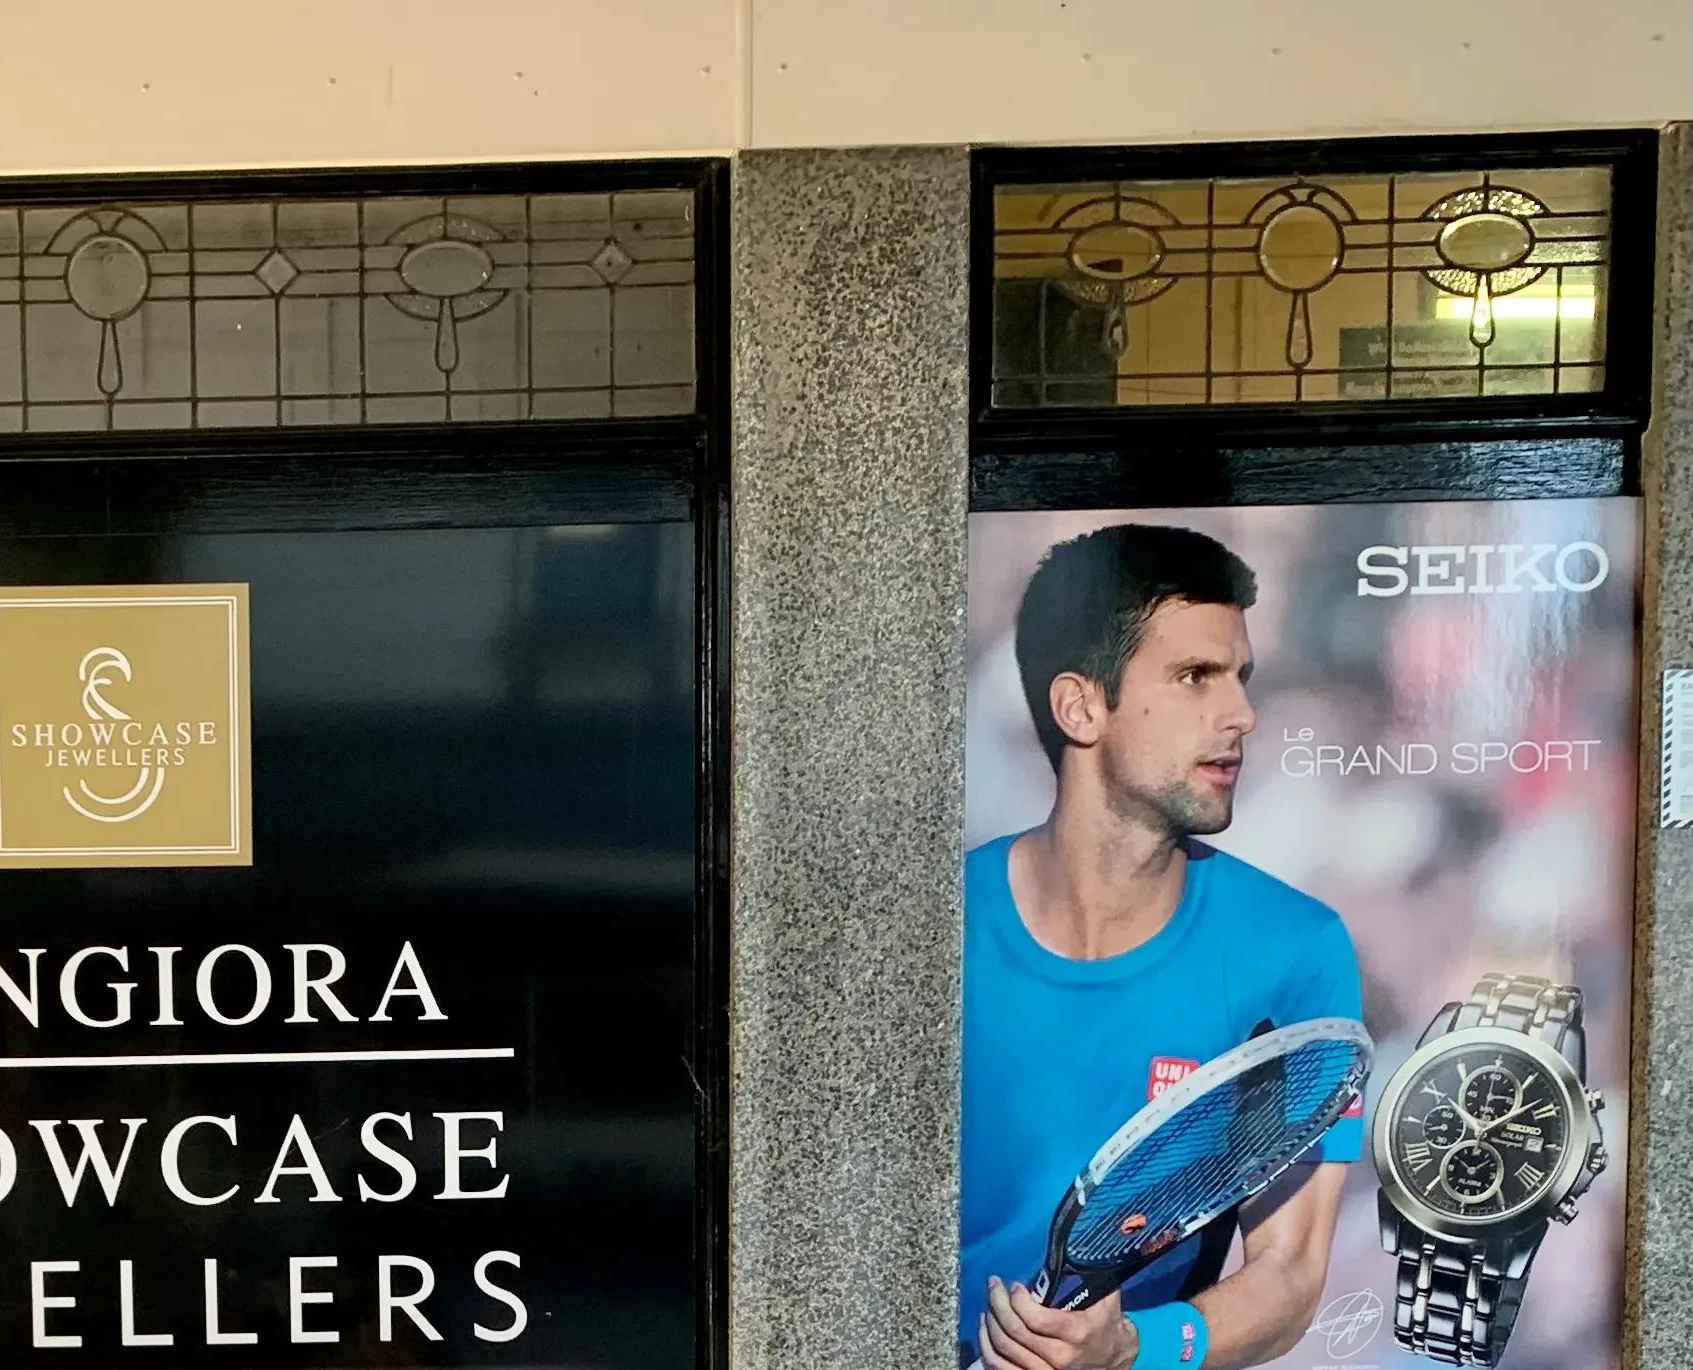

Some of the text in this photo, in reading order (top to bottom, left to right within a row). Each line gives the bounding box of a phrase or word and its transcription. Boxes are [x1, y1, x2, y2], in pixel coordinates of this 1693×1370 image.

[1356, 540, 1610, 597] SEIKO
[11, 721, 218, 748] SHOWCASE
[1283, 726, 1315, 742] Le
[45, 747, 186, 768] JEWELLERS
[1280, 739, 1602, 778] GRAND SPORT
